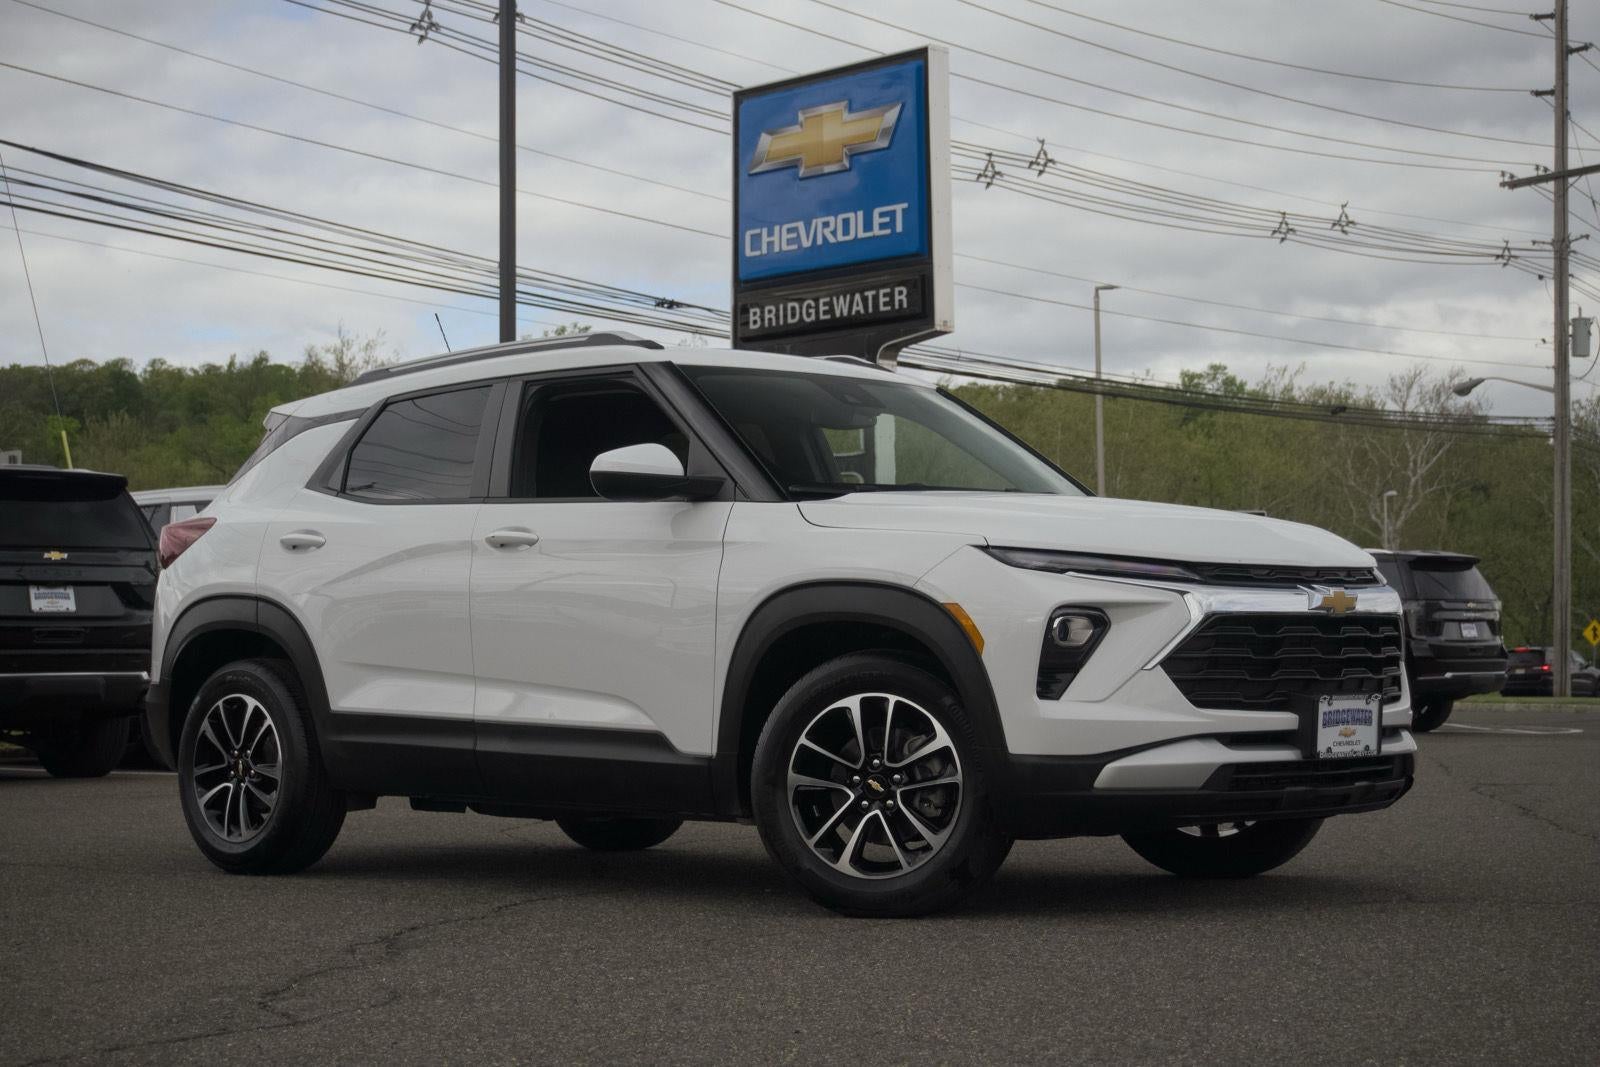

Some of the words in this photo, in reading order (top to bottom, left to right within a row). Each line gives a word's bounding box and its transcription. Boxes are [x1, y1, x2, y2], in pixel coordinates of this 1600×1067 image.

[745, 203, 908, 257] CHEVROLET
[749, 286, 908, 330] BRIDGEWATER
[1322, 708, 1373, 728] BRIDGEWATER
[1332, 739, 1361, 747] CHEVROLET
